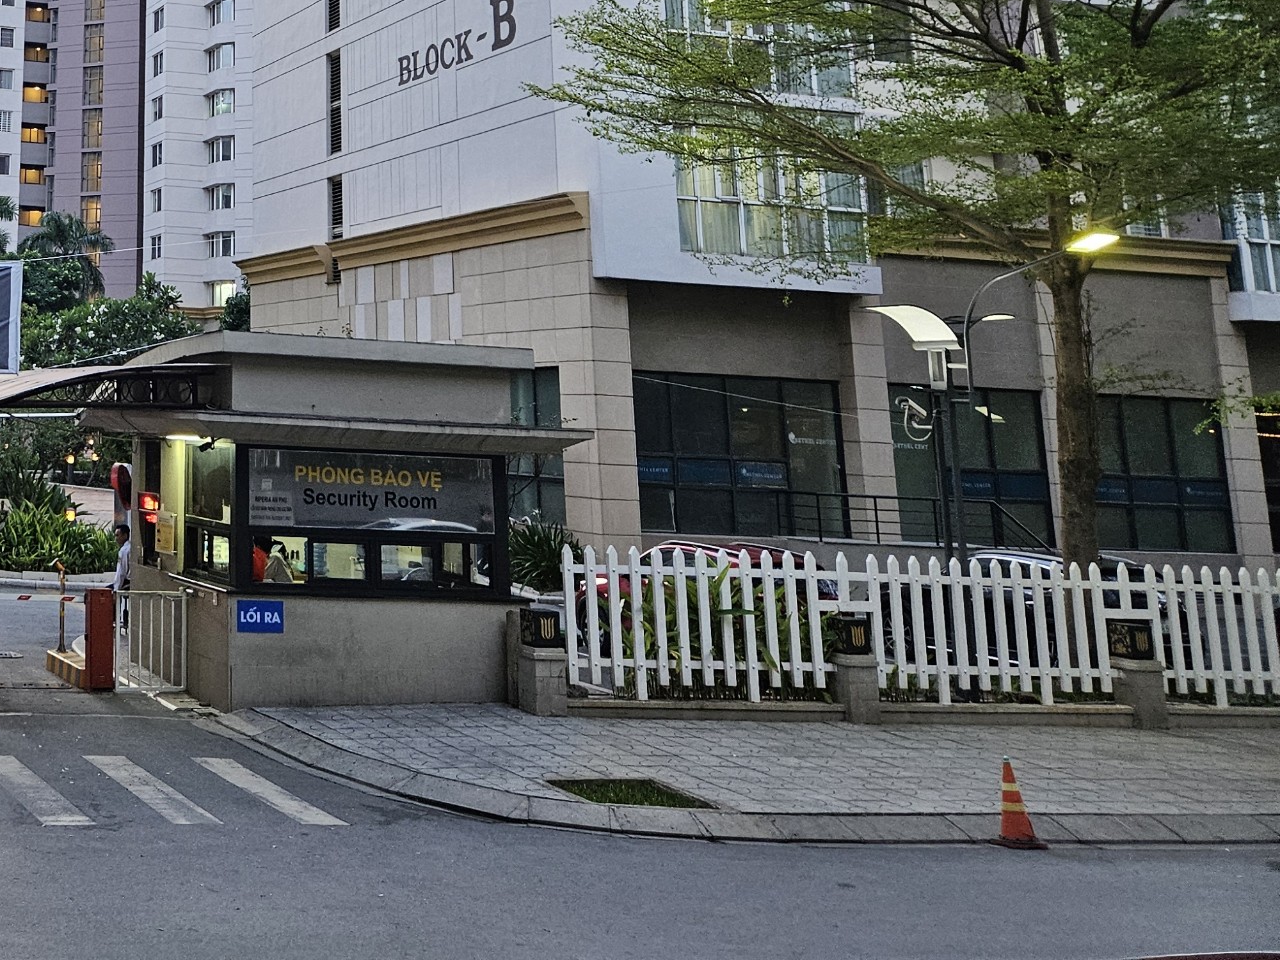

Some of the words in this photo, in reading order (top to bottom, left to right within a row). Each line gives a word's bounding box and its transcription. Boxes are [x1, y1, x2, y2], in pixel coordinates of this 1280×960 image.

[371, 464, 412, 487] BẢO
[417, 469, 443, 492] VỆ
[303, 488, 378, 511] Security
[384, 491, 437, 509] Room
[240, 607, 261, 624] LỐI
[264, 611, 281, 624] RA
